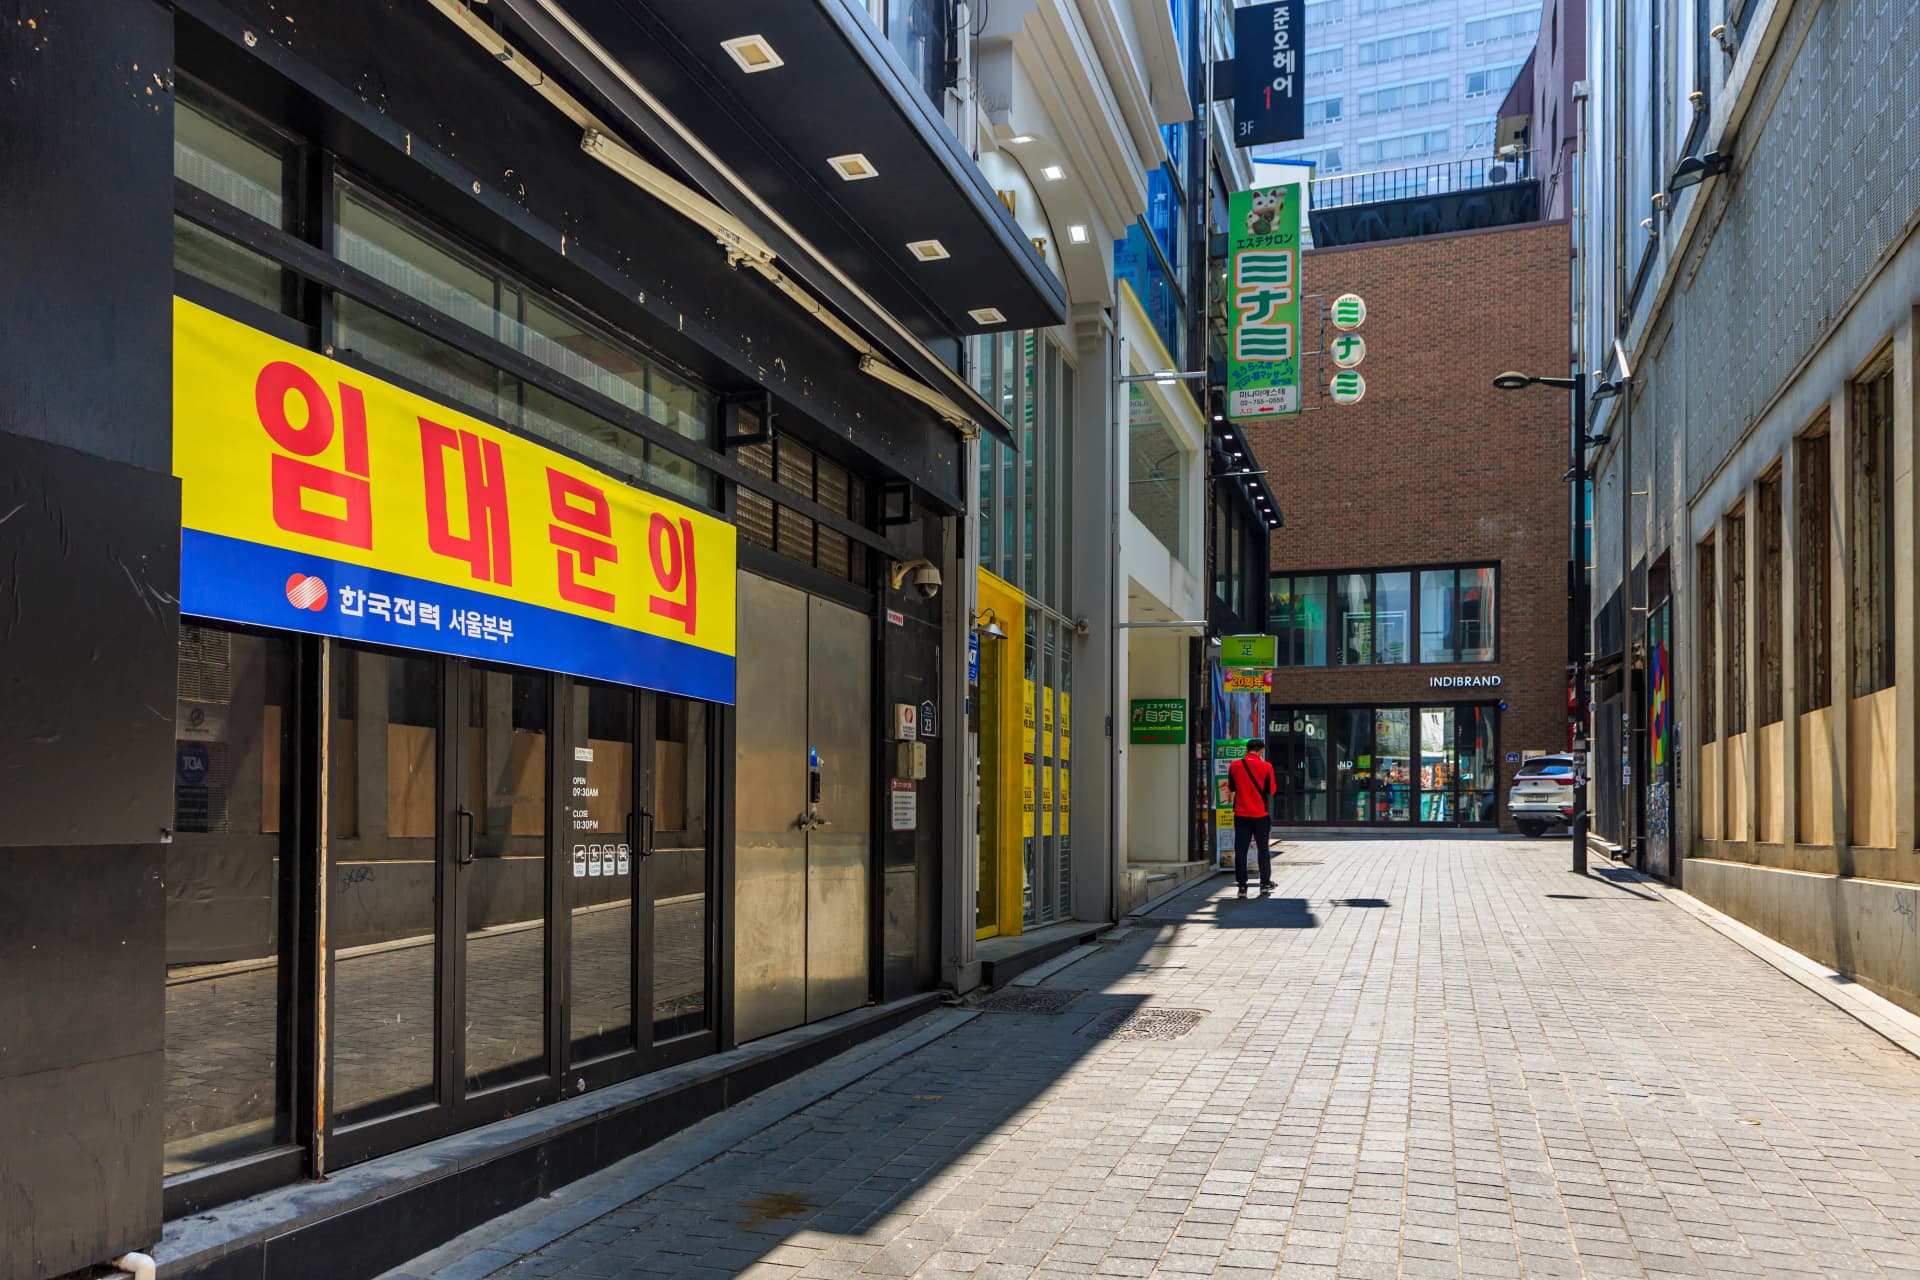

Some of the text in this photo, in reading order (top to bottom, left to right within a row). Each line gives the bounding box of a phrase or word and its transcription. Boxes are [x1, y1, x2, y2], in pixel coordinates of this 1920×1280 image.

[1272, 6, 1295, 98] 준오헤어
[1239, 120, 1255, 136] 3F
[1236, 233, 1293, 249] エステサロン
[1240, 254, 1288, 357] ミナミ
[1239, 388, 1285, 398] 미나미에스테
[255, 361, 698, 636] 임대문의
[339, 585, 514, 644] 한국전력 서울본부
[1429, 675, 1501, 688] INDIBRAND
[1145, 710, 1184, 722] ミナミ
[924, 718, 933, 732] 23
[572, 776, 587, 785] OPEN
[572, 787, 599, 797] 09:30AM
[572, 809, 589, 818] CLOSE
[572, 820, 599, 830] 10:30PM
